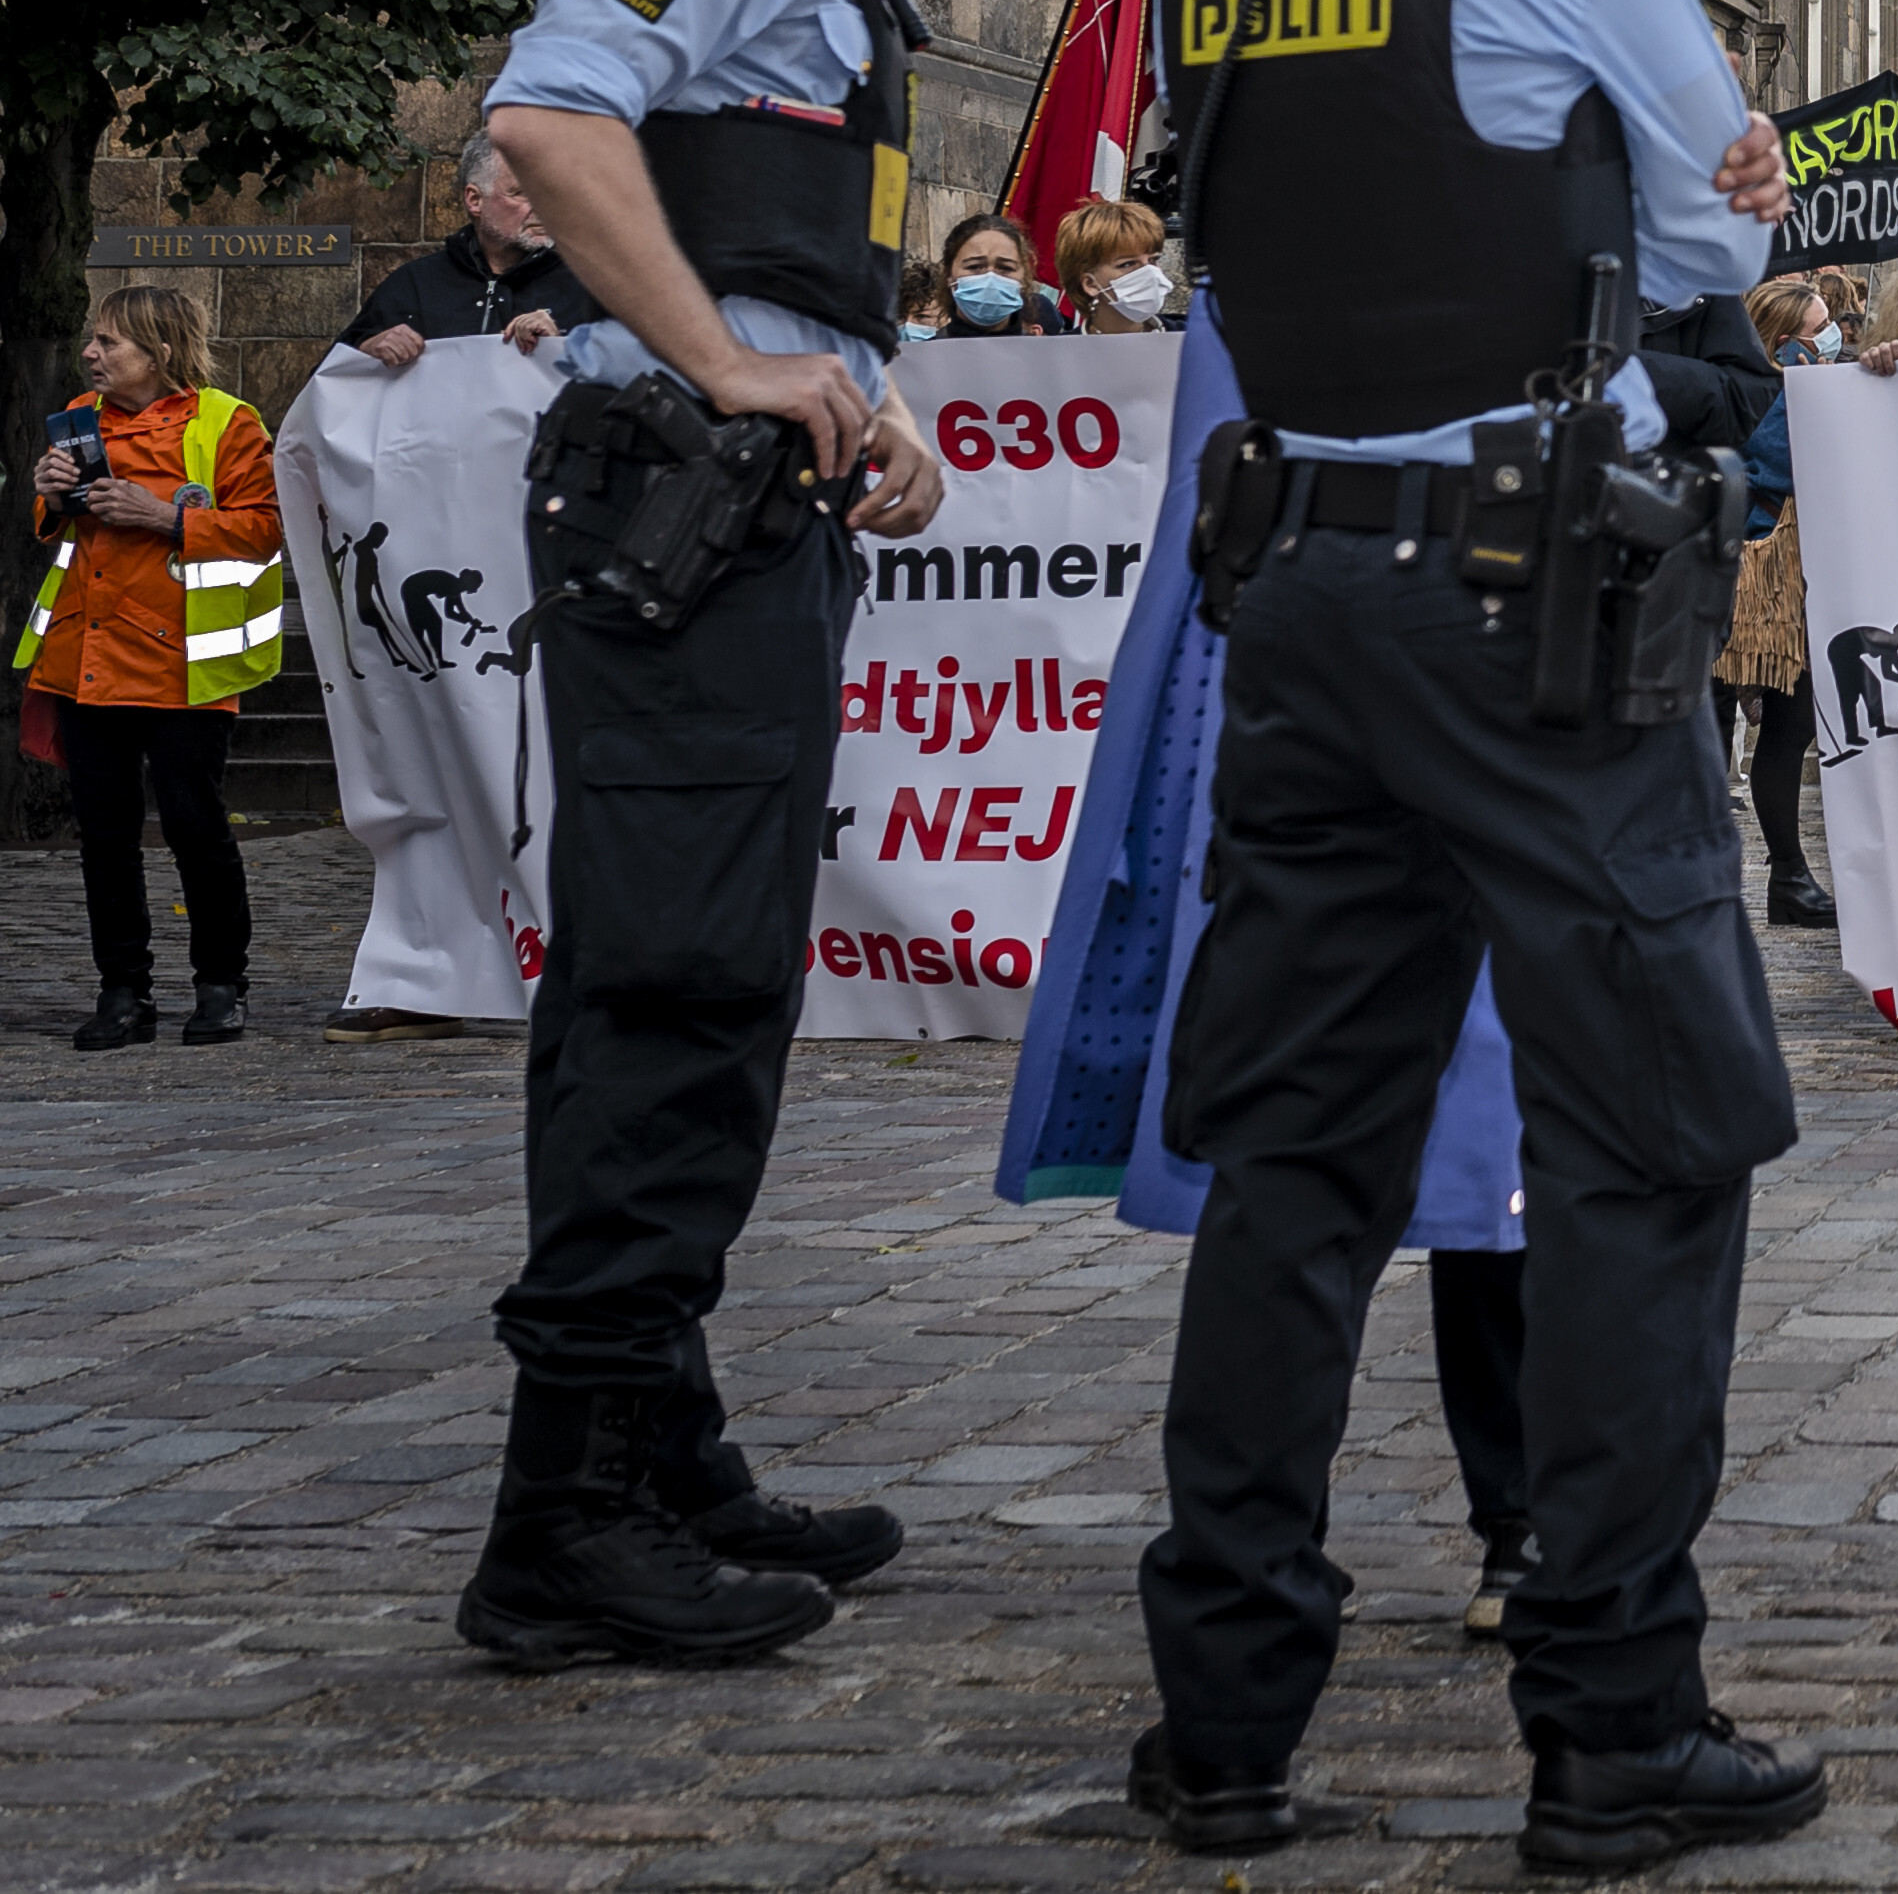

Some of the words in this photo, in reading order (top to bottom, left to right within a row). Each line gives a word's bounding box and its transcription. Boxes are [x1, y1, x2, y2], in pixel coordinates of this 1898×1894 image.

[127, 235, 193, 257] THE
[203, 234, 315, 257] TOWER
[937, 398, 1119, 471] 630
[875, 543, 1142, 602] mmer
[841, 657, 1106, 754] dtjylla
[879, 786, 1075, 861] NEJ
[806, 910, 1046, 989] ensio
